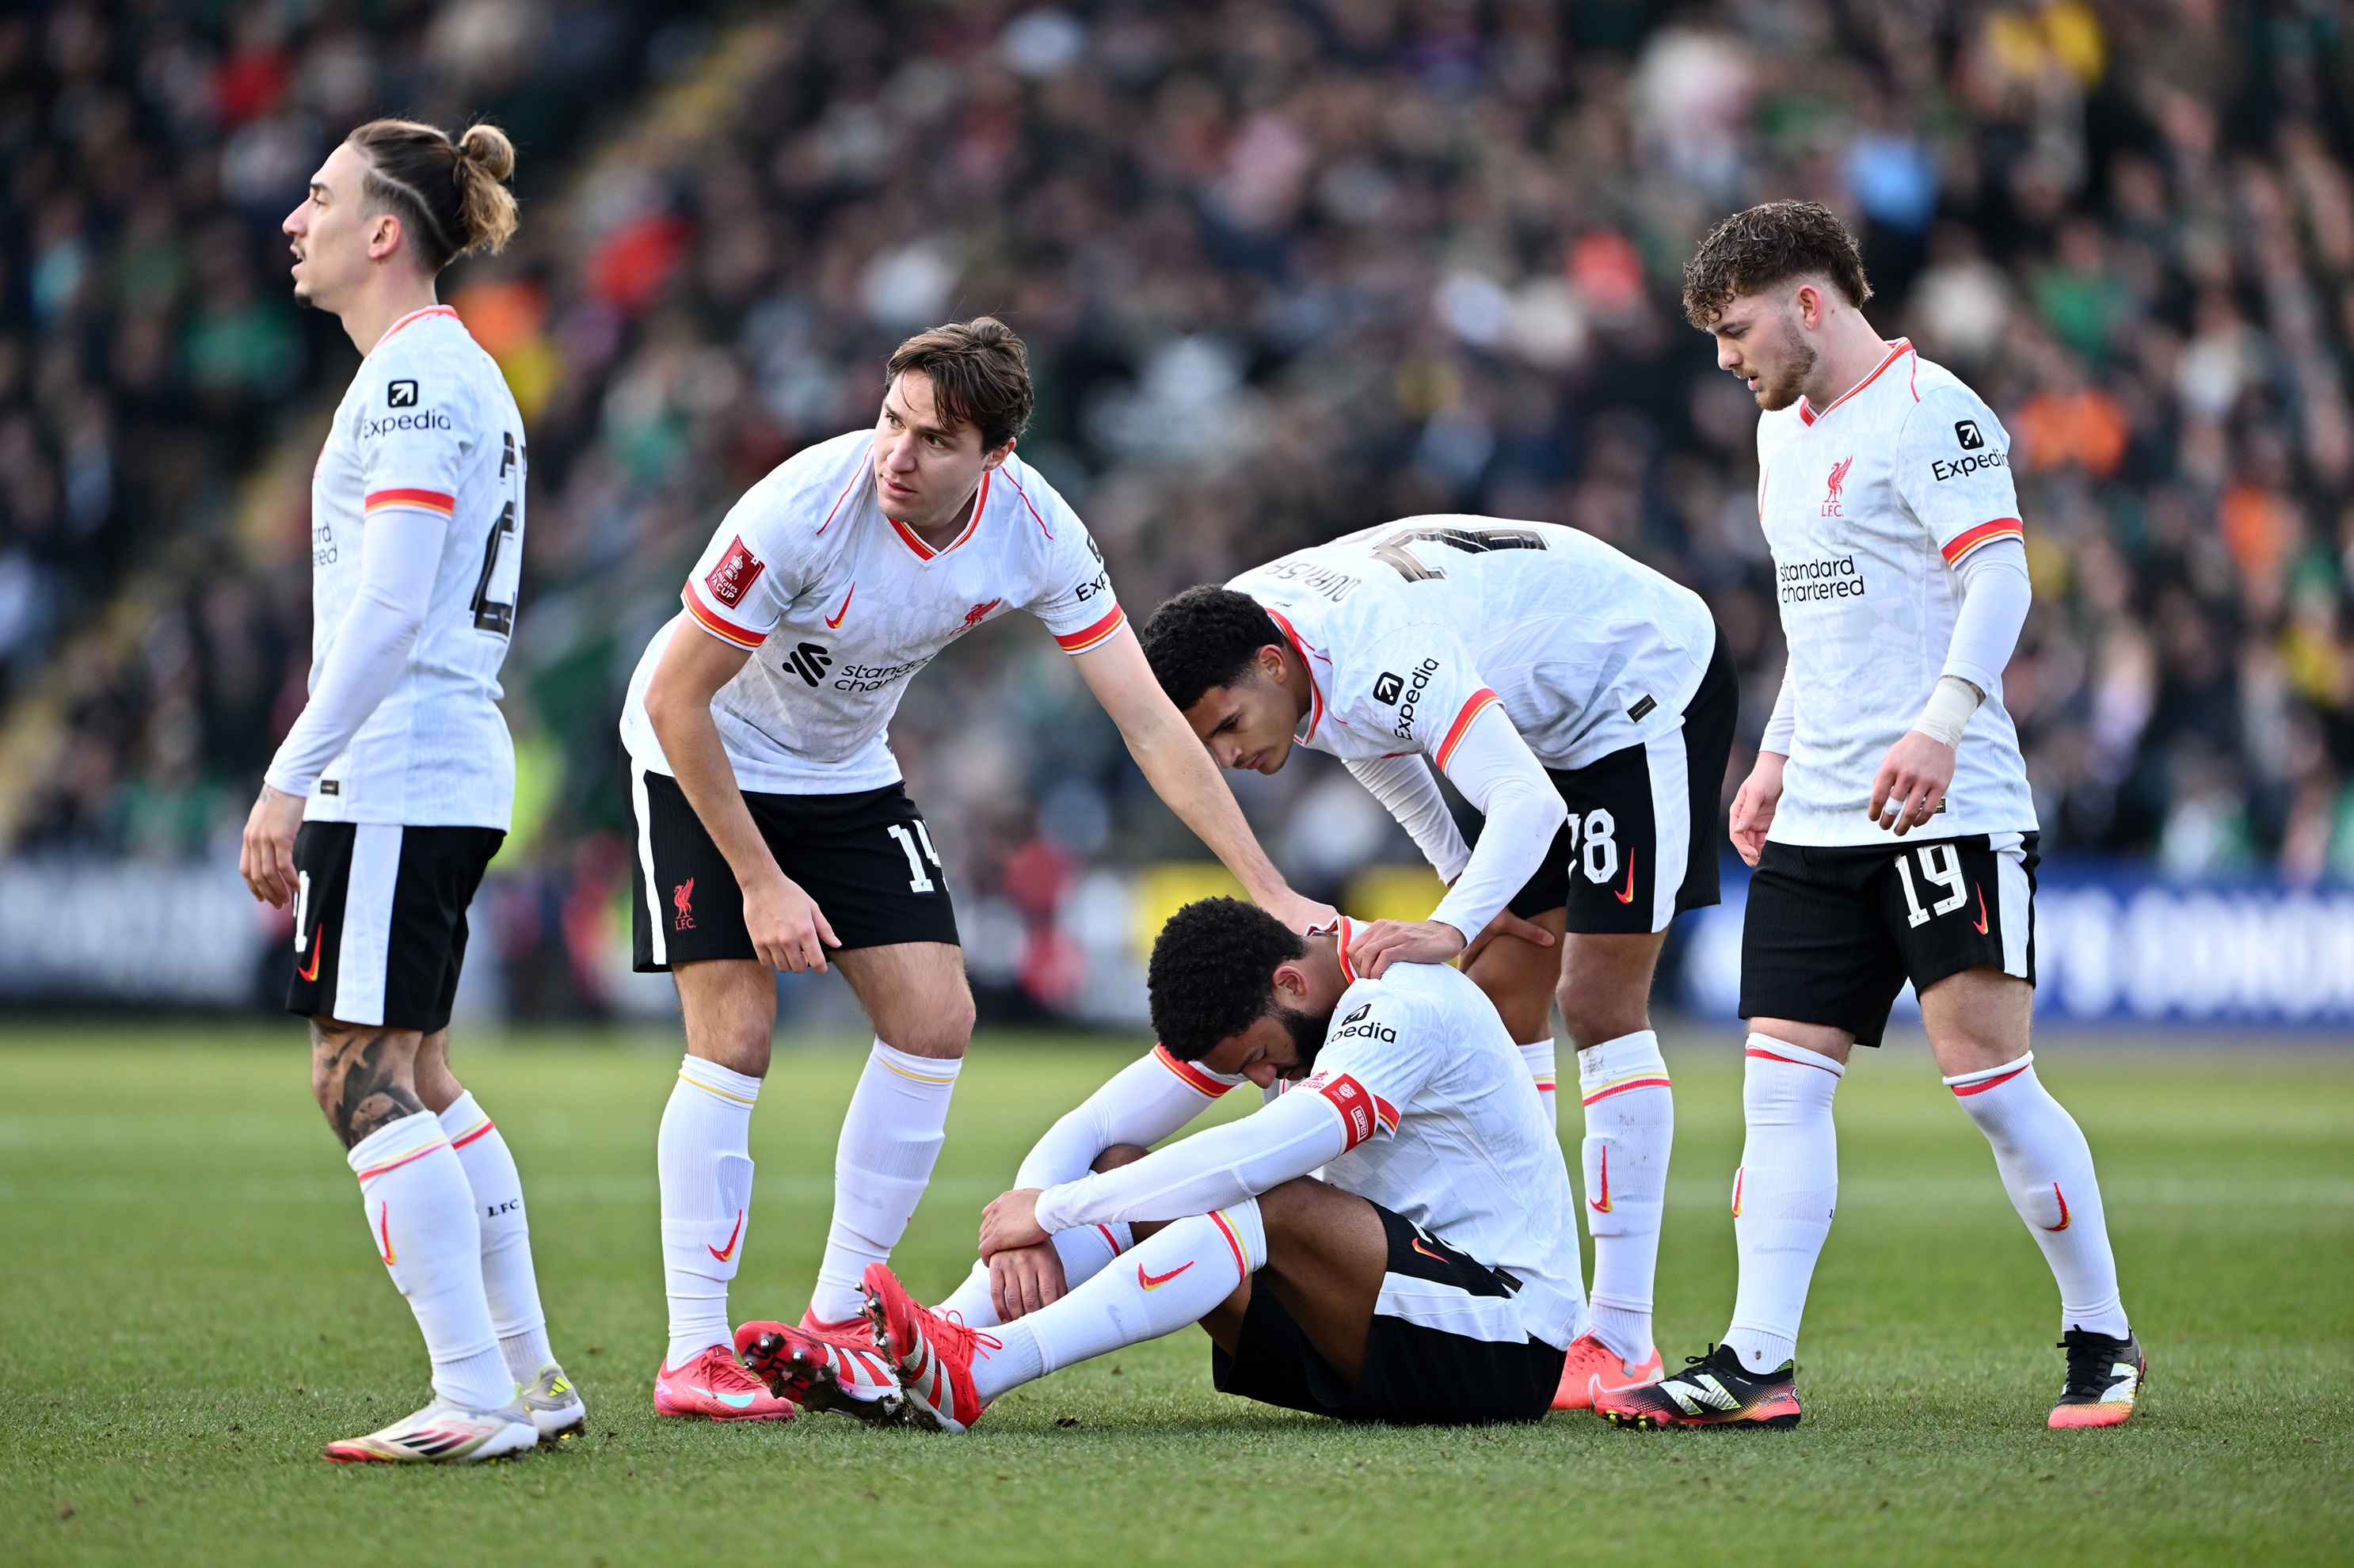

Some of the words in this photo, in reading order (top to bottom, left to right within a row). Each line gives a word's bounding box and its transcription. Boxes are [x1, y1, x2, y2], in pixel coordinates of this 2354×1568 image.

[715, 567, 739, 594] Emirates
[1780, 554, 1855, 582] standard
[716, 584, 735, 599] CUP
[1782, 575, 1865, 603] chartered
[1394, 657, 1440, 740] Expedia
[1894, 843, 1968, 929] 19
[1354, 1109, 1367, 1136] RESPECT
